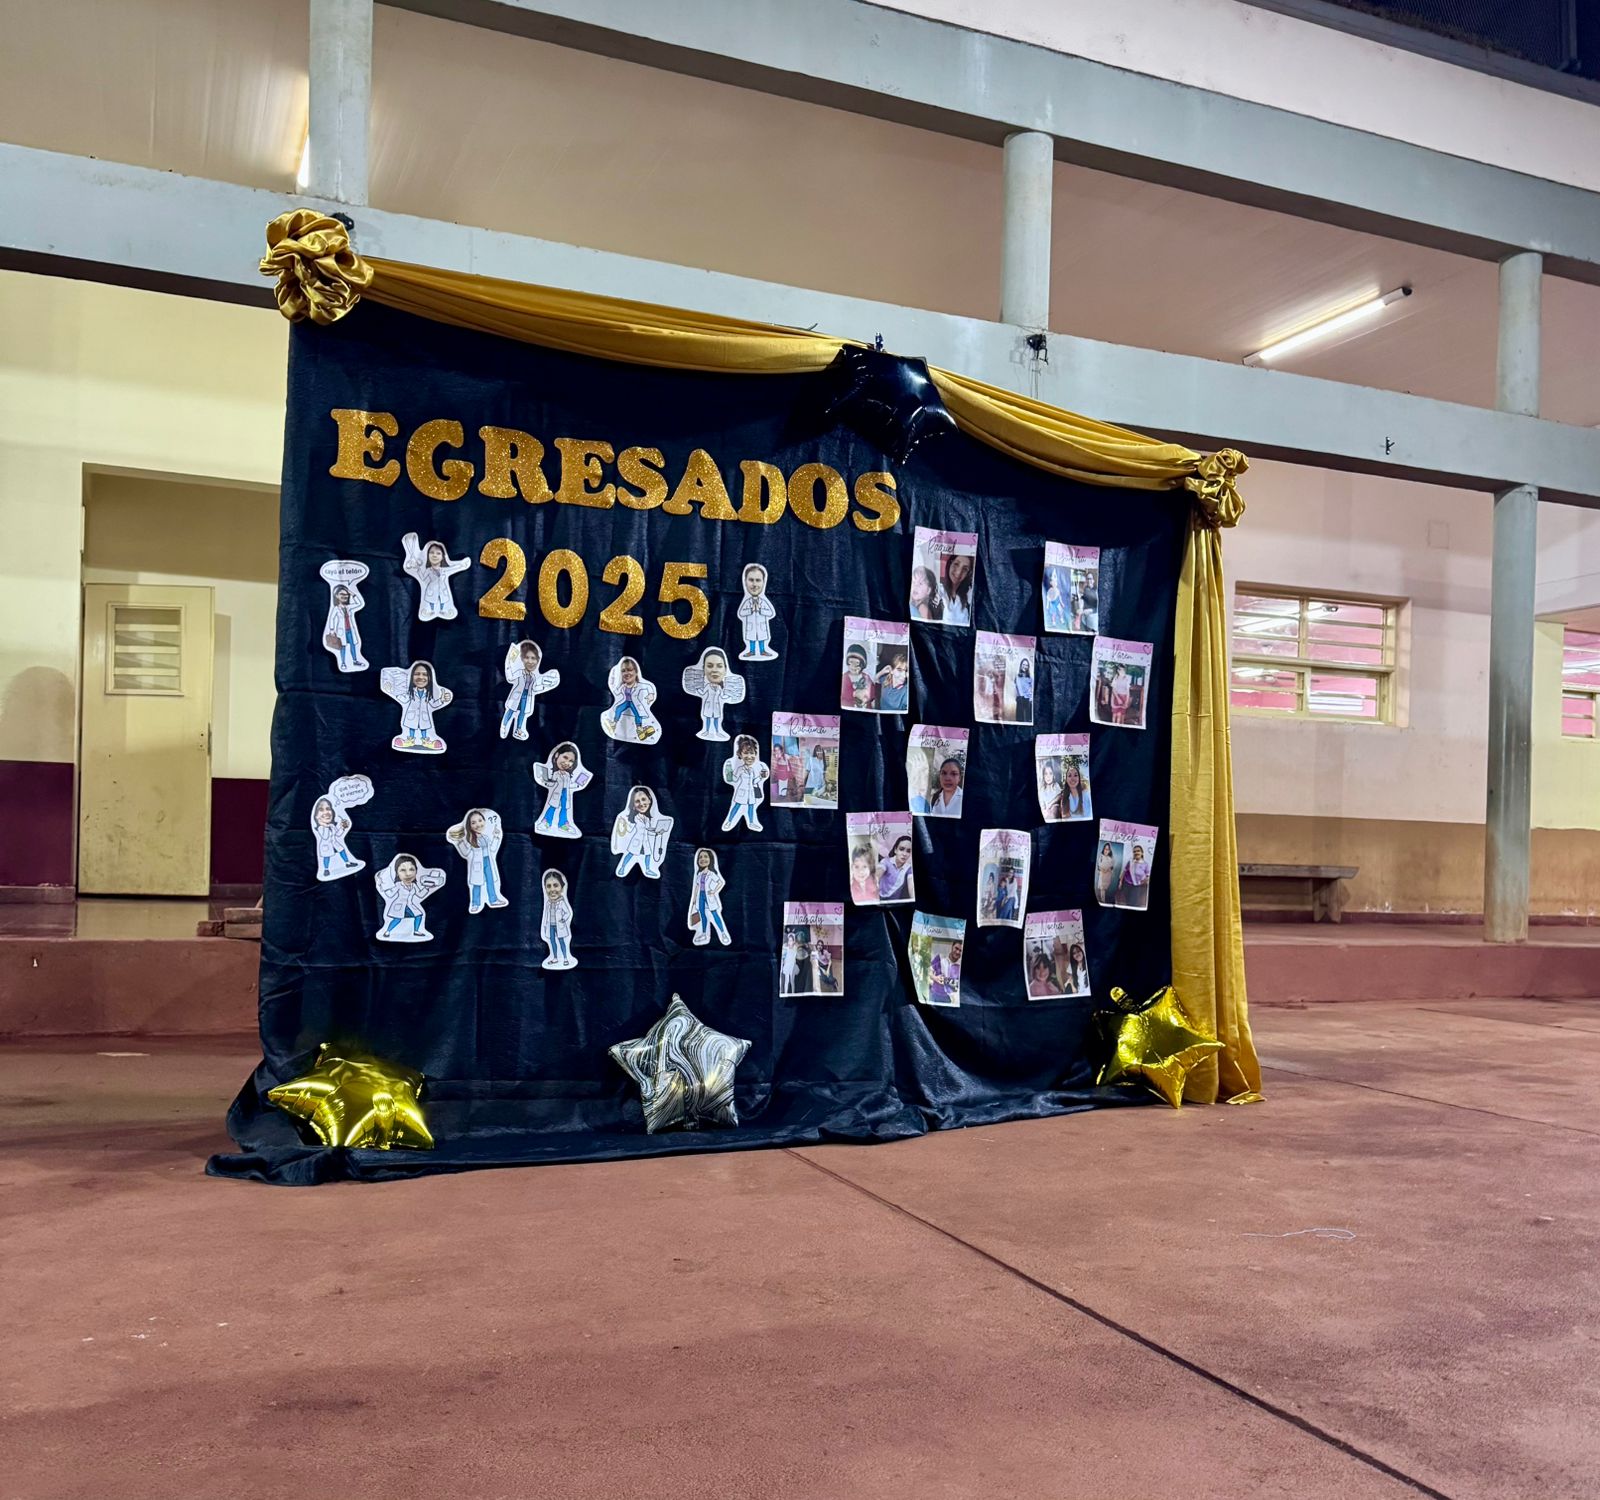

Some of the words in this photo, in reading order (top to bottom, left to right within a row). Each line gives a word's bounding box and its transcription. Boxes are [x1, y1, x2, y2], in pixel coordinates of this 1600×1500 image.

[330, 408, 902, 532] EGRESADOS
[928, 536, 957, 556] Raquel
[478, 538, 709, 641] 2025
[793, 908, 824, 929] Magaly
